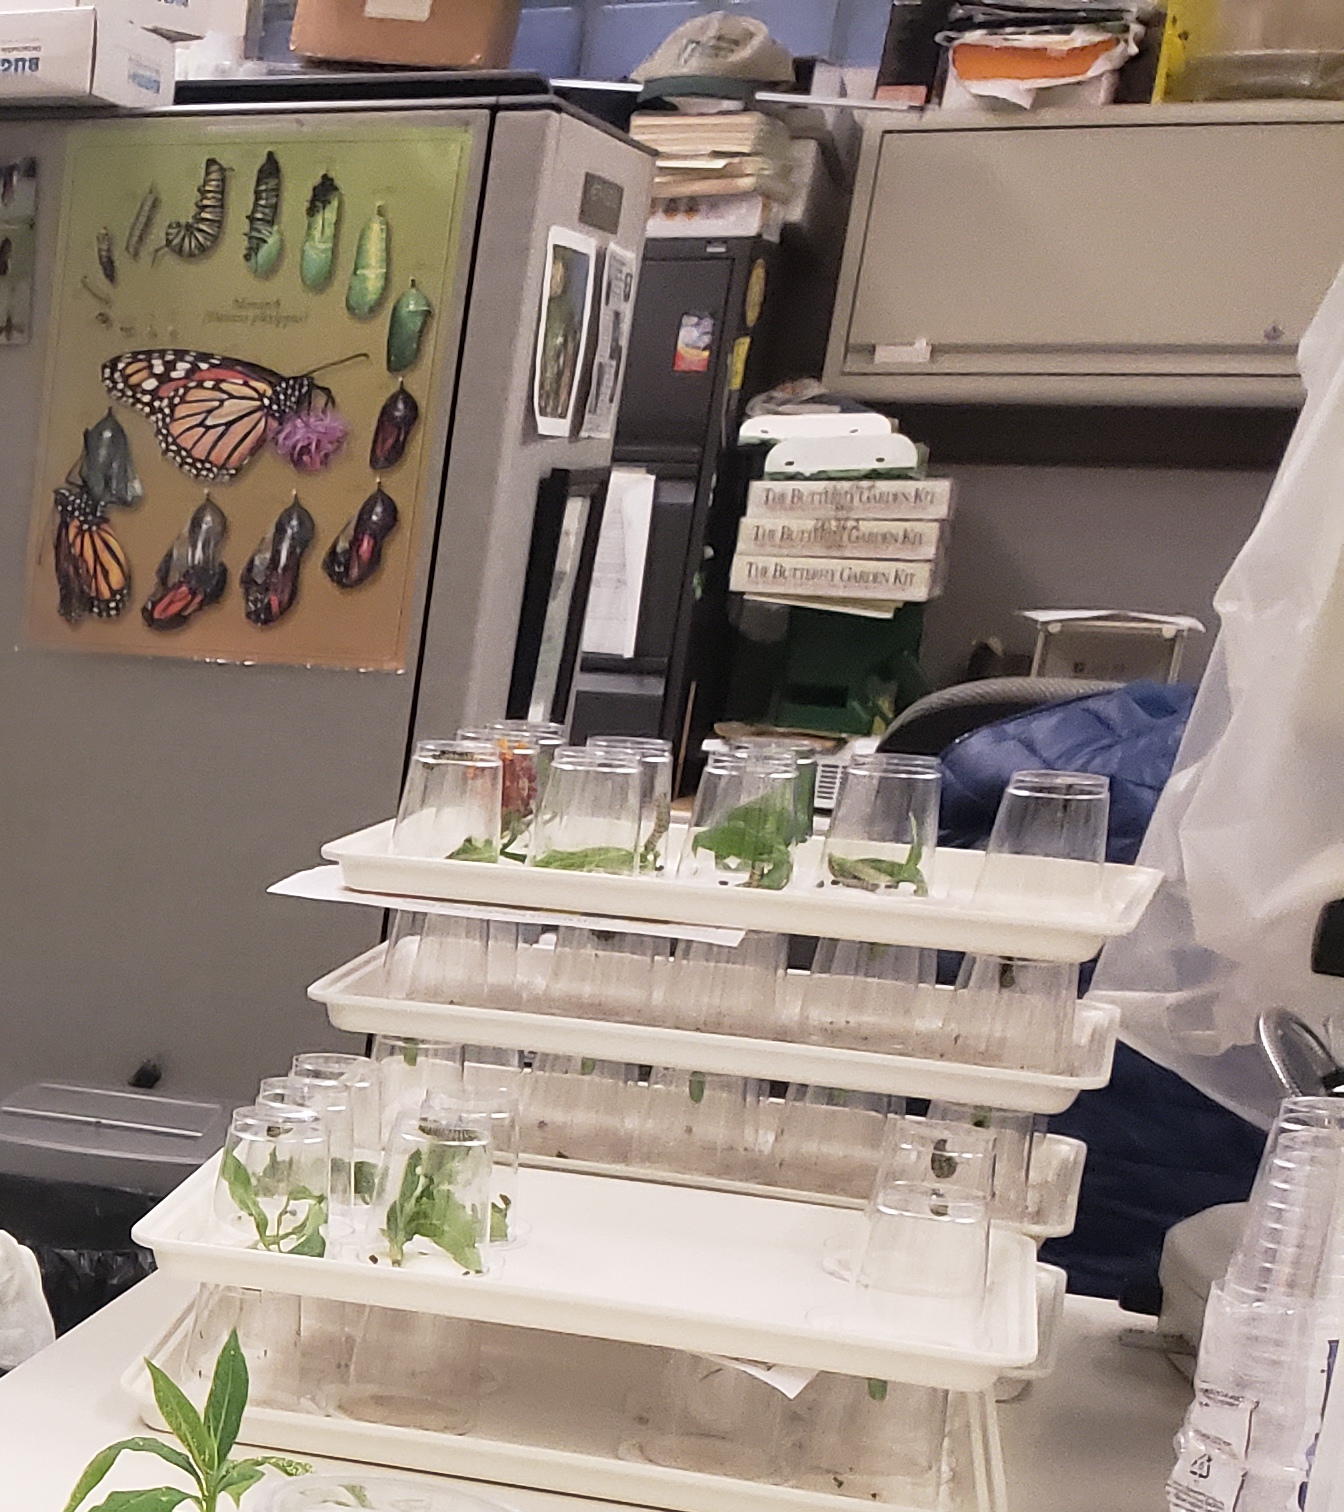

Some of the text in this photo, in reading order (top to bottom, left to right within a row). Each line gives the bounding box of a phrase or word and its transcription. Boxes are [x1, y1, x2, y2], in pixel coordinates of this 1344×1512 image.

[746, 561, 768, 579] THE
[840, 566, 889, 584] GARDEN
[893, 567, 917, 586] KIT
